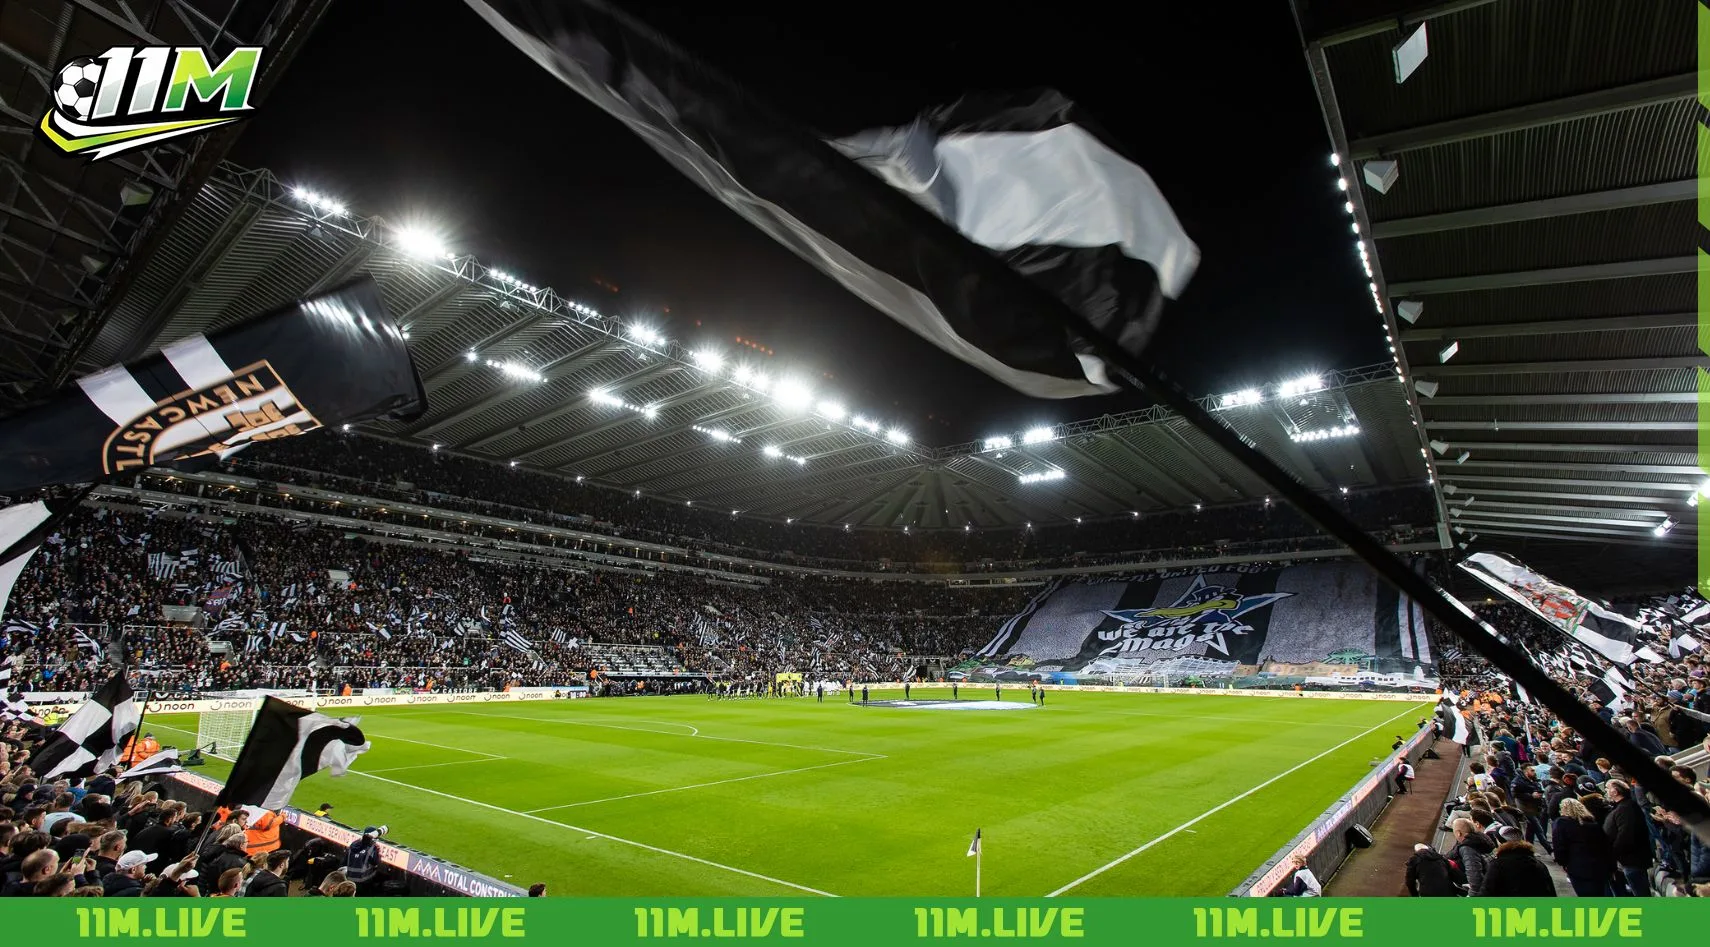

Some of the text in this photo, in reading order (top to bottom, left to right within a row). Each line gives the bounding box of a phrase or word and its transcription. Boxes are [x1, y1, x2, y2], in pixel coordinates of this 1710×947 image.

[115, 373, 266, 472] NEWCASTL
[1148, 622, 1197, 636] are
[1203, 621, 1255, 635] the
[164, 703, 195, 711] noon
[223, 701, 252, 709] noon
[329, 697, 353, 705] noon
[374, 696, 396, 704] noon
[443, 869, 520, 898] TOTAL CONST
